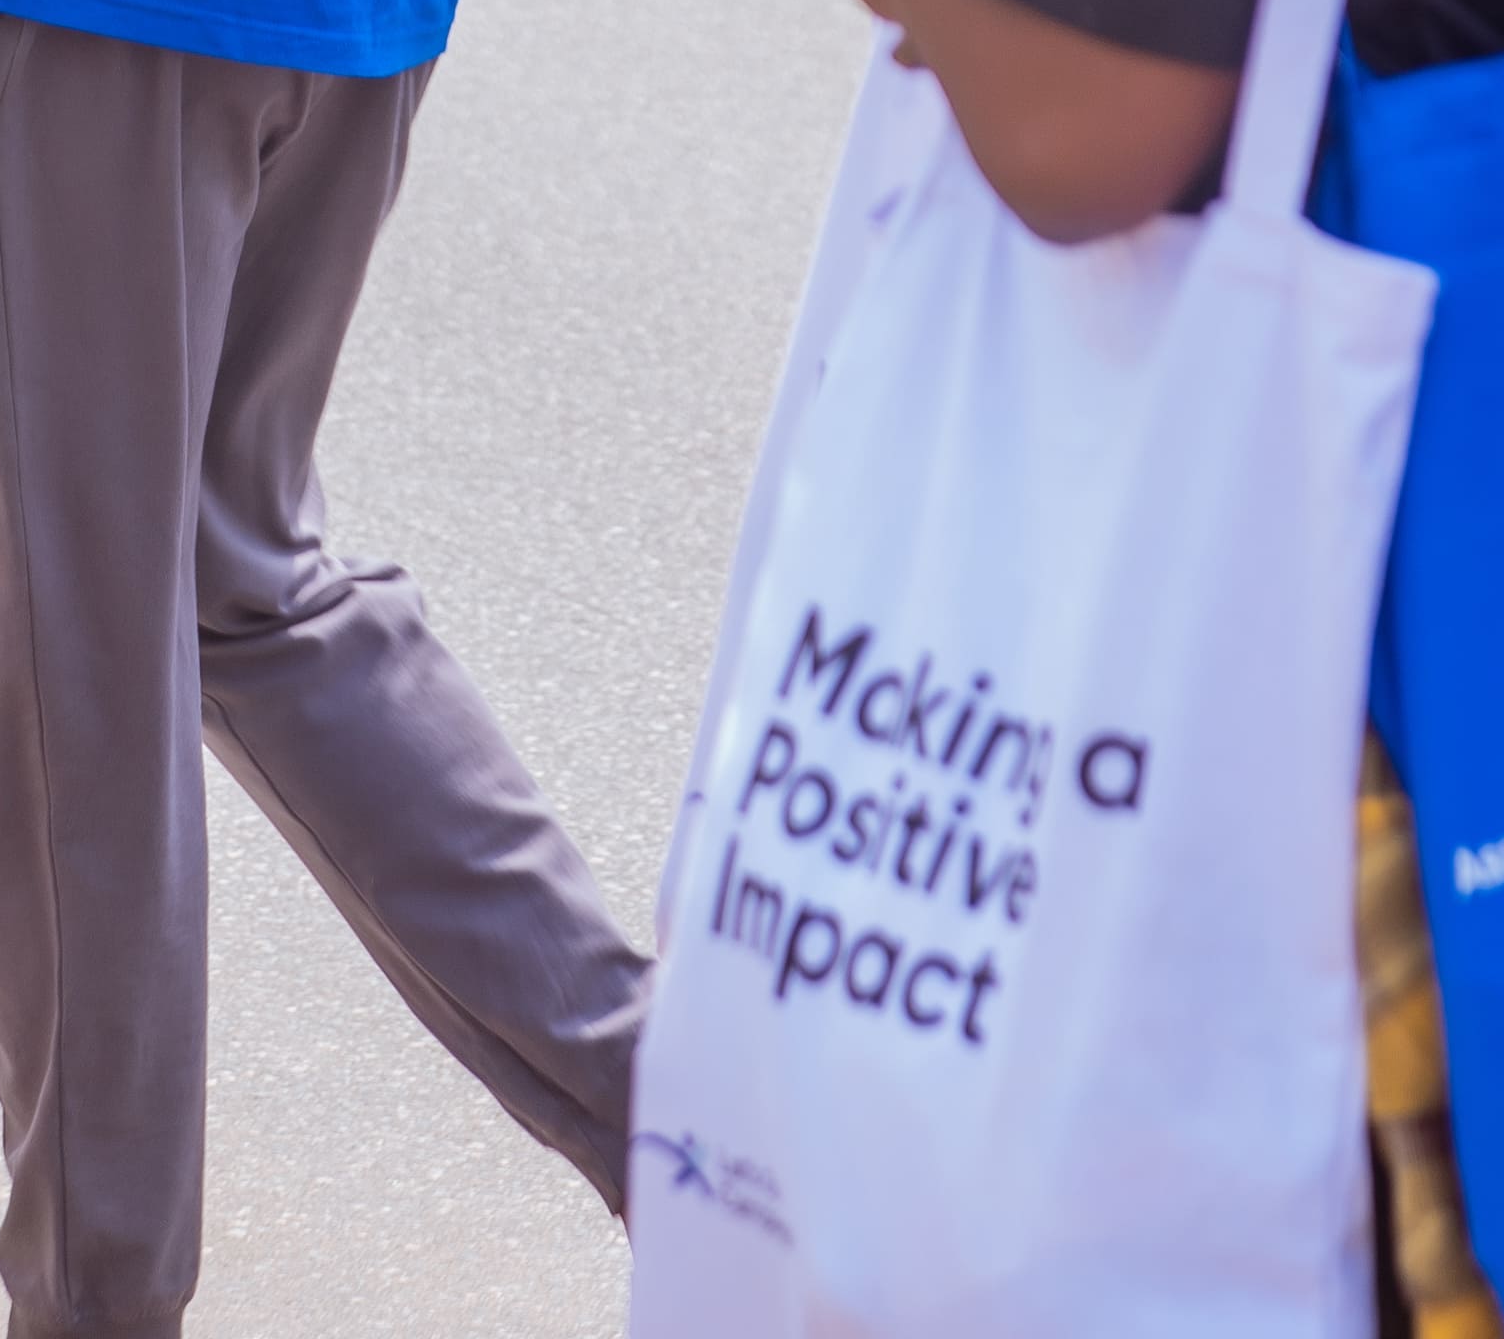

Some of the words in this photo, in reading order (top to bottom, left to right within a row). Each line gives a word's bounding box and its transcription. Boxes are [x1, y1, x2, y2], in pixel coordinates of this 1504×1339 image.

[737, 716, 1038, 927] Positive
[1078, 731, 1150, 812] a
[710, 833, 1000, 1048] Impact
